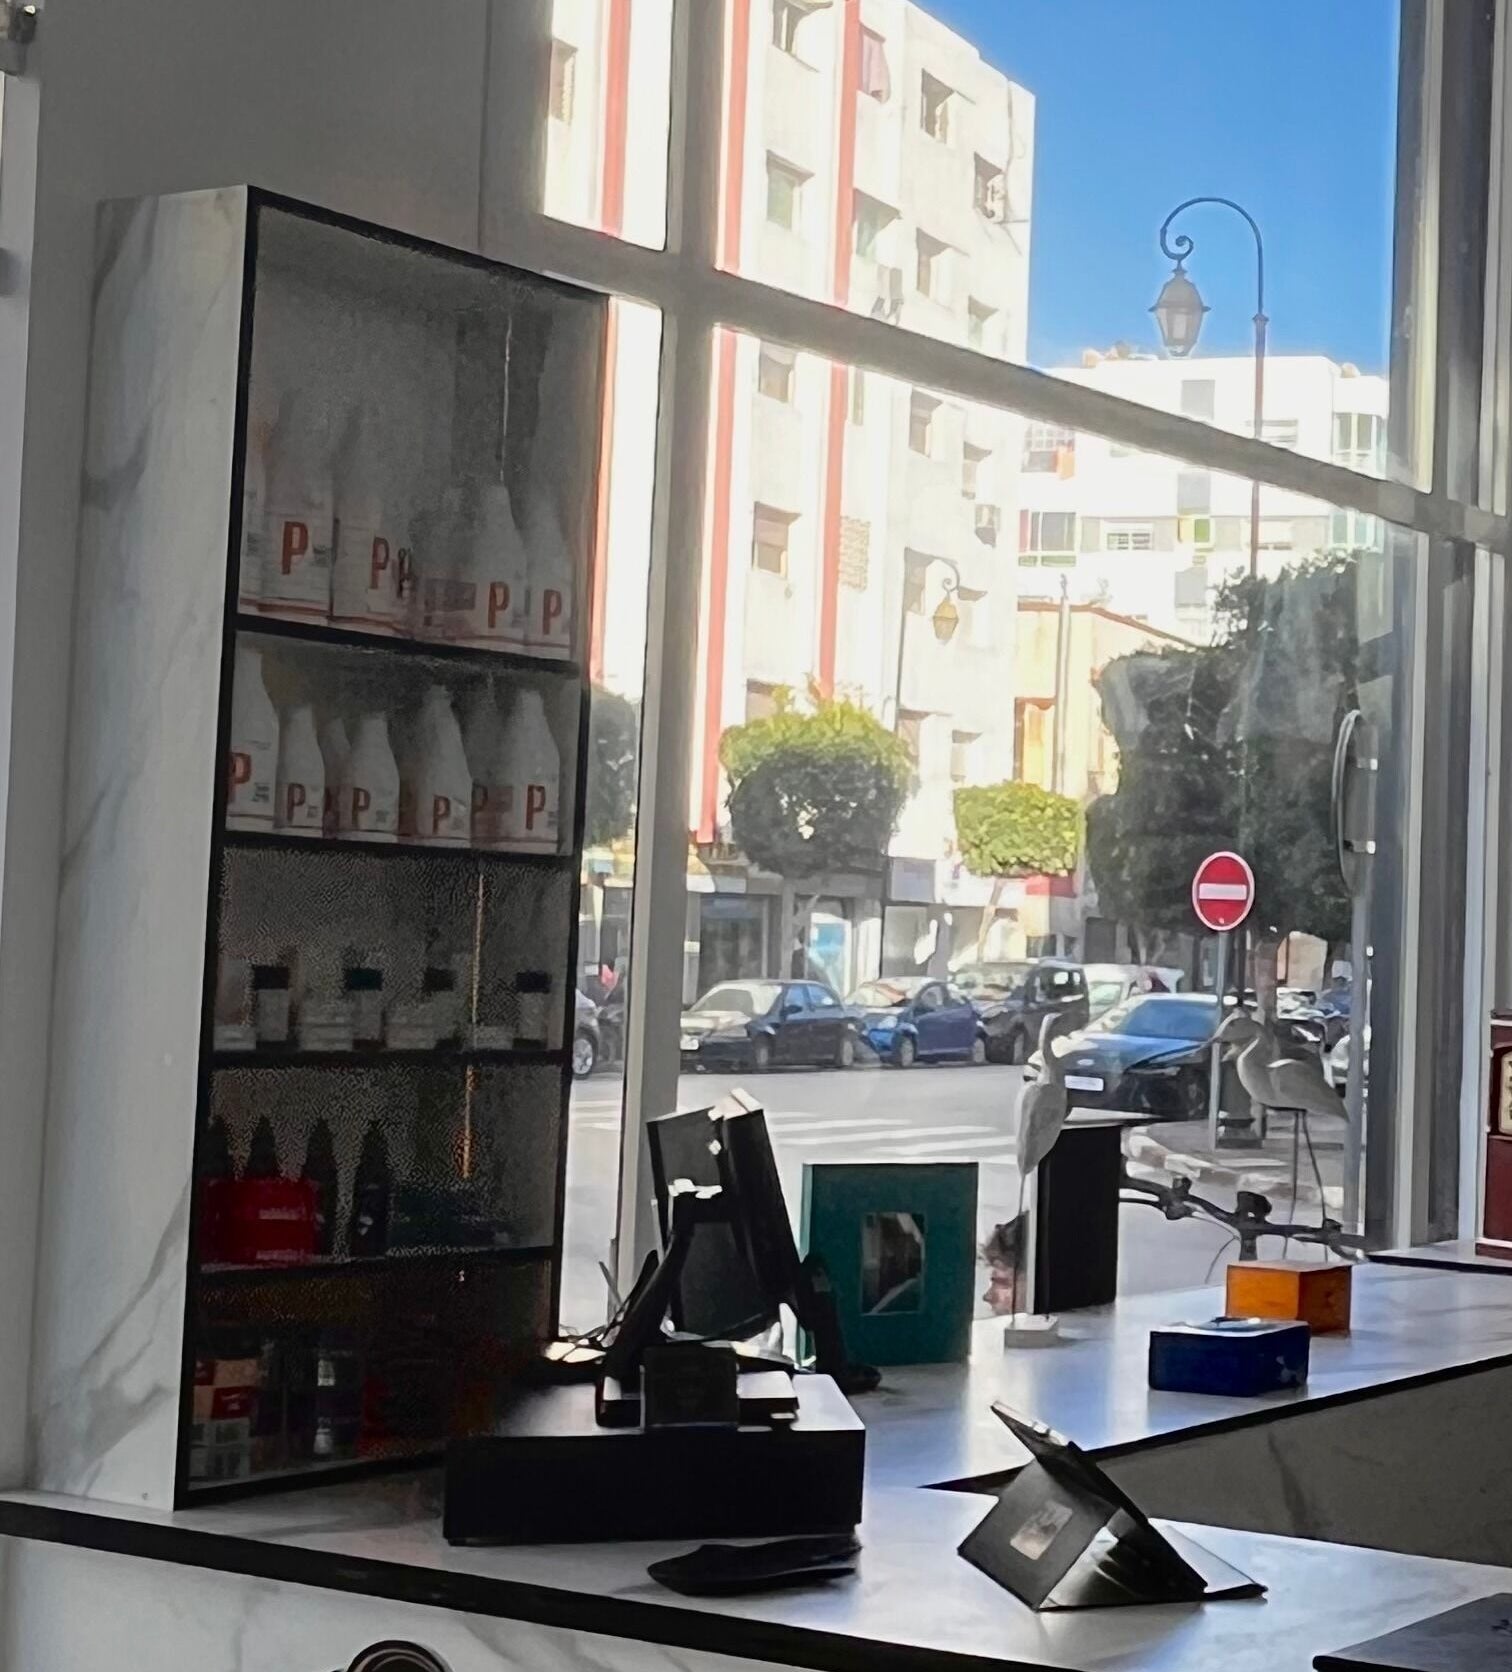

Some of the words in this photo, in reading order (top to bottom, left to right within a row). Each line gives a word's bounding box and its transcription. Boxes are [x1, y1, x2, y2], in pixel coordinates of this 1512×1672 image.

[281, 521, 308, 575] P
[370, 536, 390, 589] P
[487, 581, 510, 629] P
[541, 589, 562, 635] P
[227, 752, 251, 803] P
[287, 783, 306, 824] P
[352, 787, 371, 829] P
[432, 794, 450, 834] P
[526, 784, 546, 830] P
